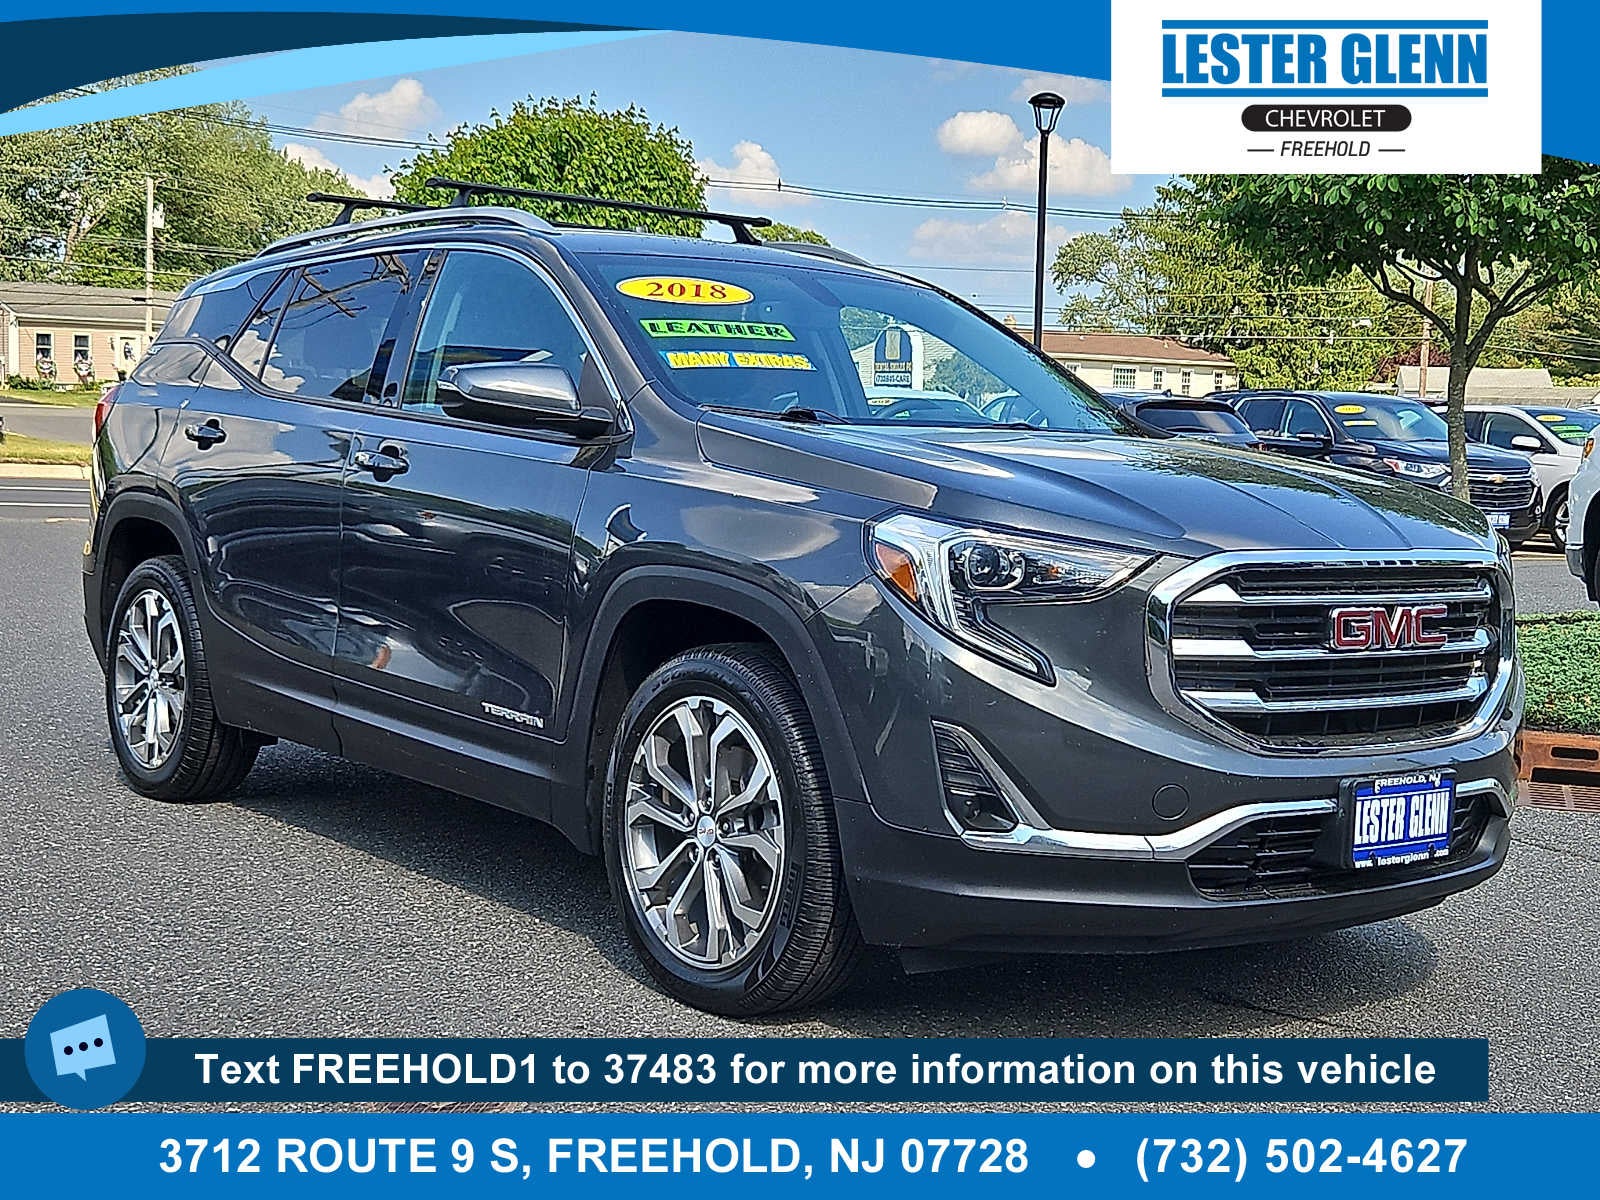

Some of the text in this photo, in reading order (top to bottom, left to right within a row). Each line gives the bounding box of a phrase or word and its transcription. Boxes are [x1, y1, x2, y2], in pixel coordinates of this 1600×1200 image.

[646, 281, 727, 299] 2018
[649, 321, 789, 338] LEATHER
[666, 352, 812, 370] MANY EXTRAS
[1329, 604, 1448, 649] GMC
[480, 701, 544, 728] TERRAIN
[1375, 774, 1427, 788] FREEHOLD,
[1354, 792, 1449, 845] LESTER GLENN
